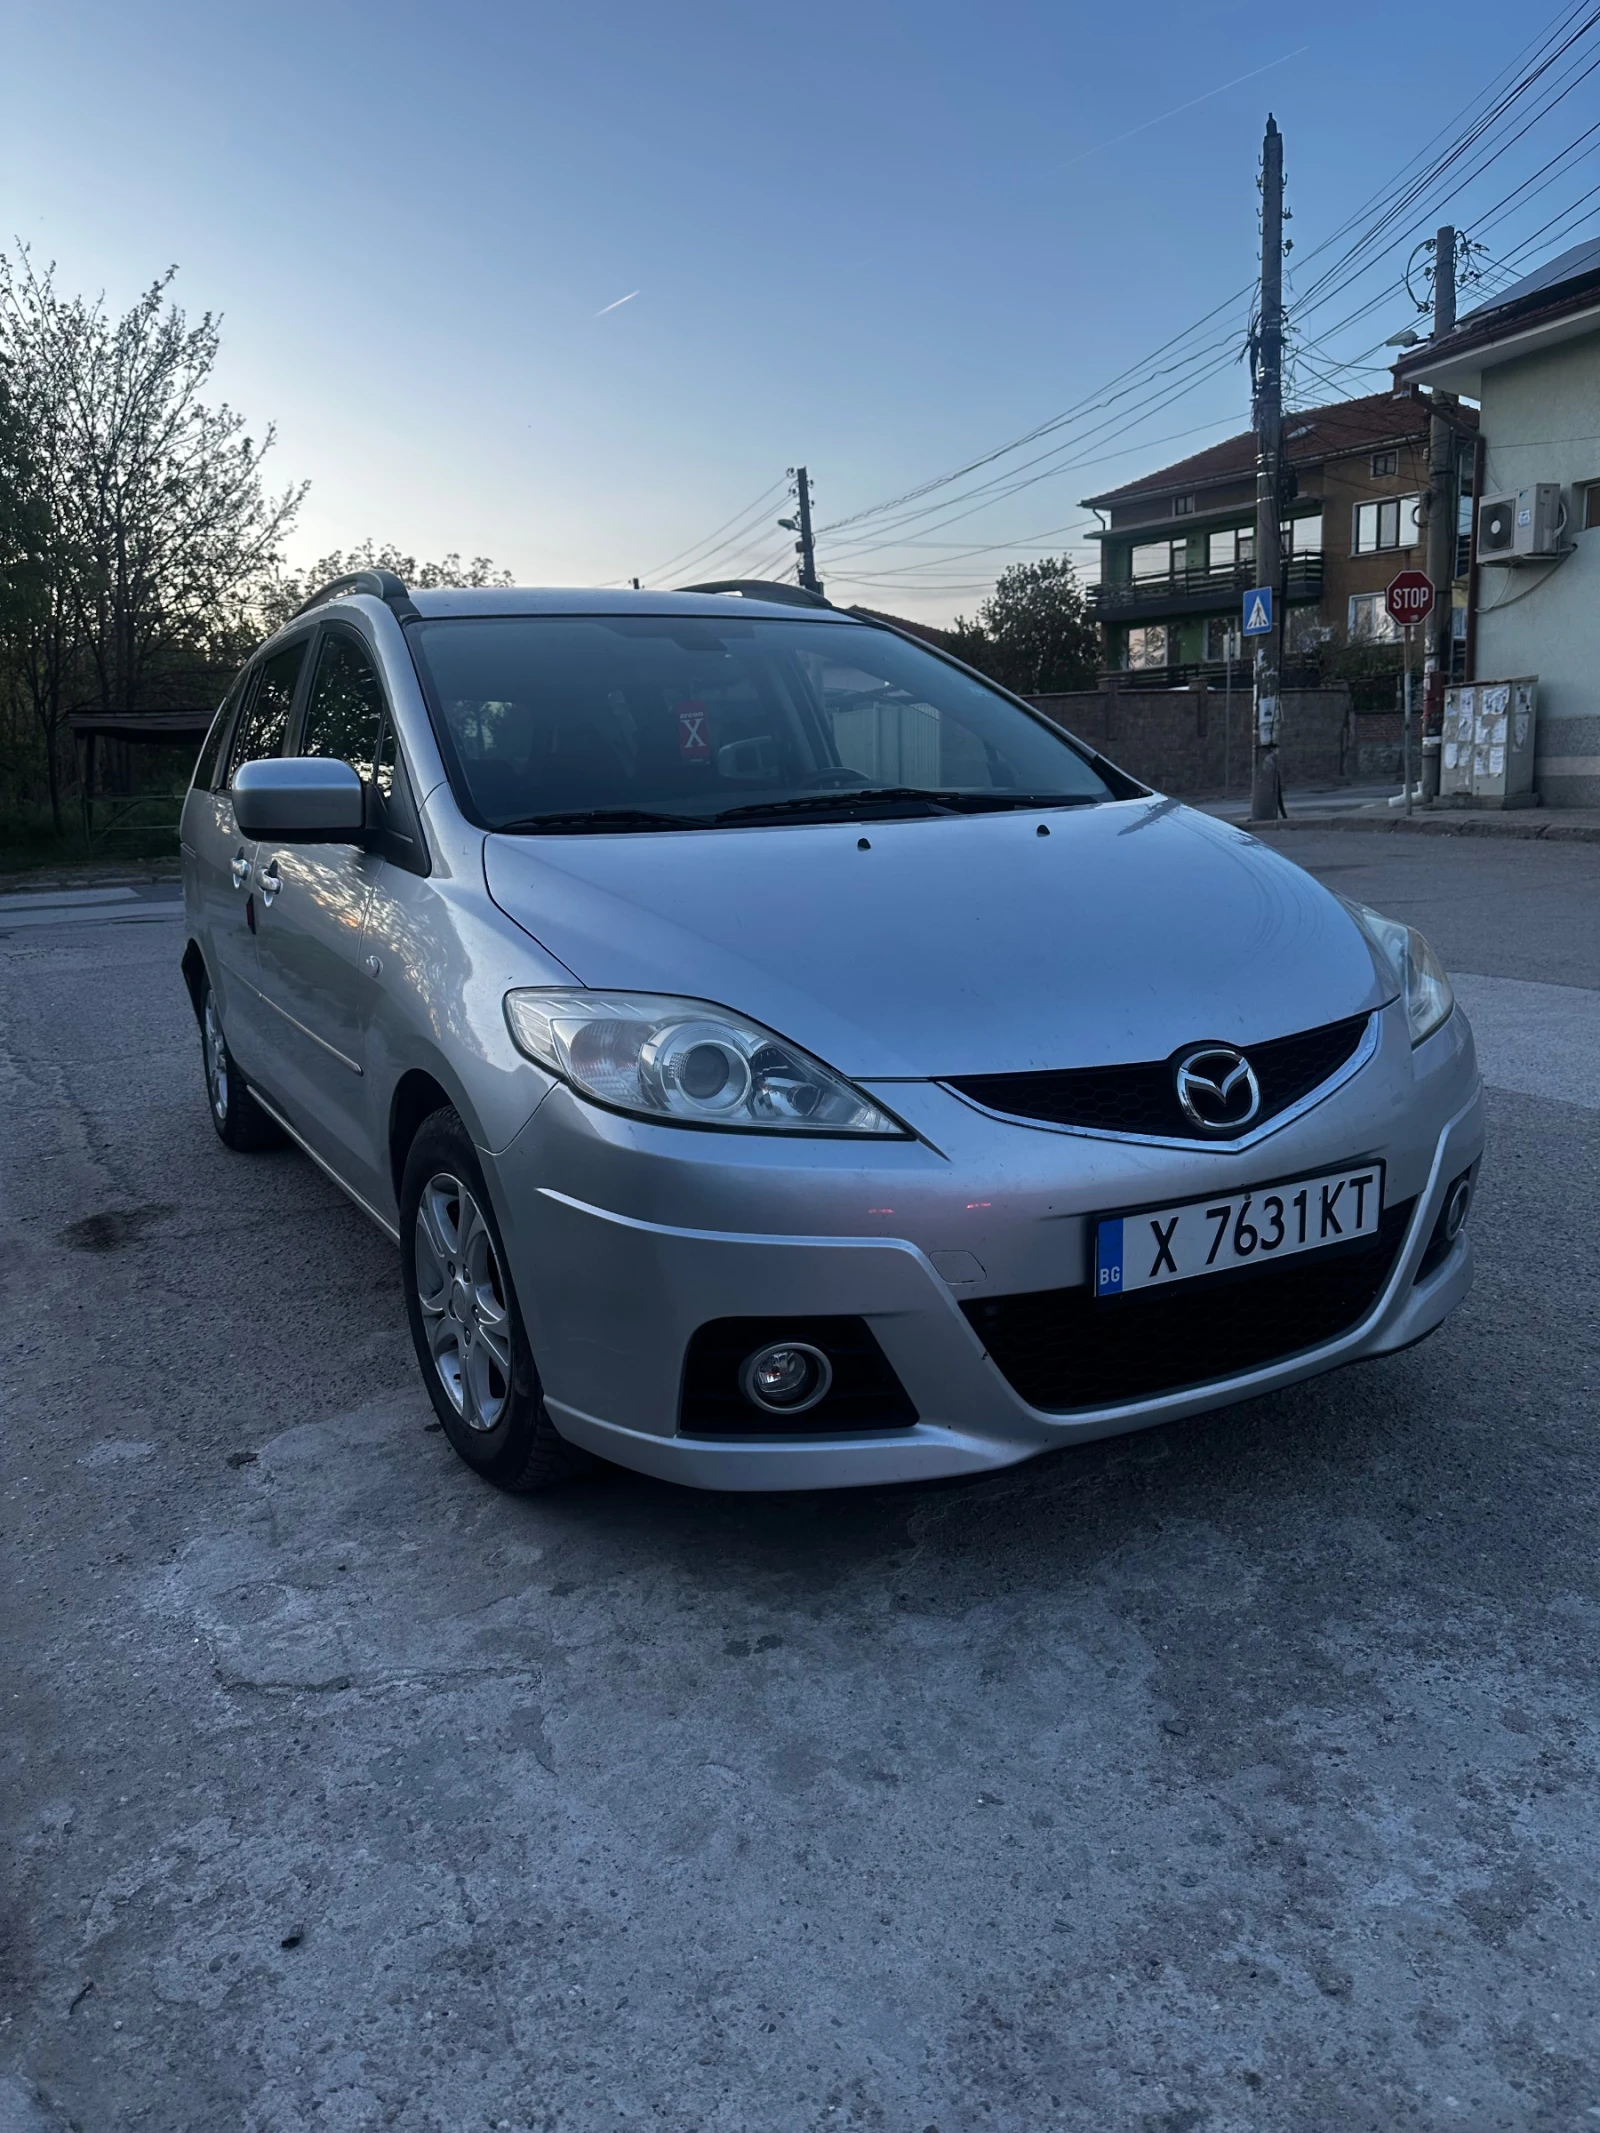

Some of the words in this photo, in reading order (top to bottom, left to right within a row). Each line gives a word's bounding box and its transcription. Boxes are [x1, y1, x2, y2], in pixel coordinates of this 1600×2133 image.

[1393, 587, 1429, 609] STOP
[680, 718, 707, 749] X
[1149, 1216, 1179, 1278] X
[1099, 1265, 1120, 1285] BG
